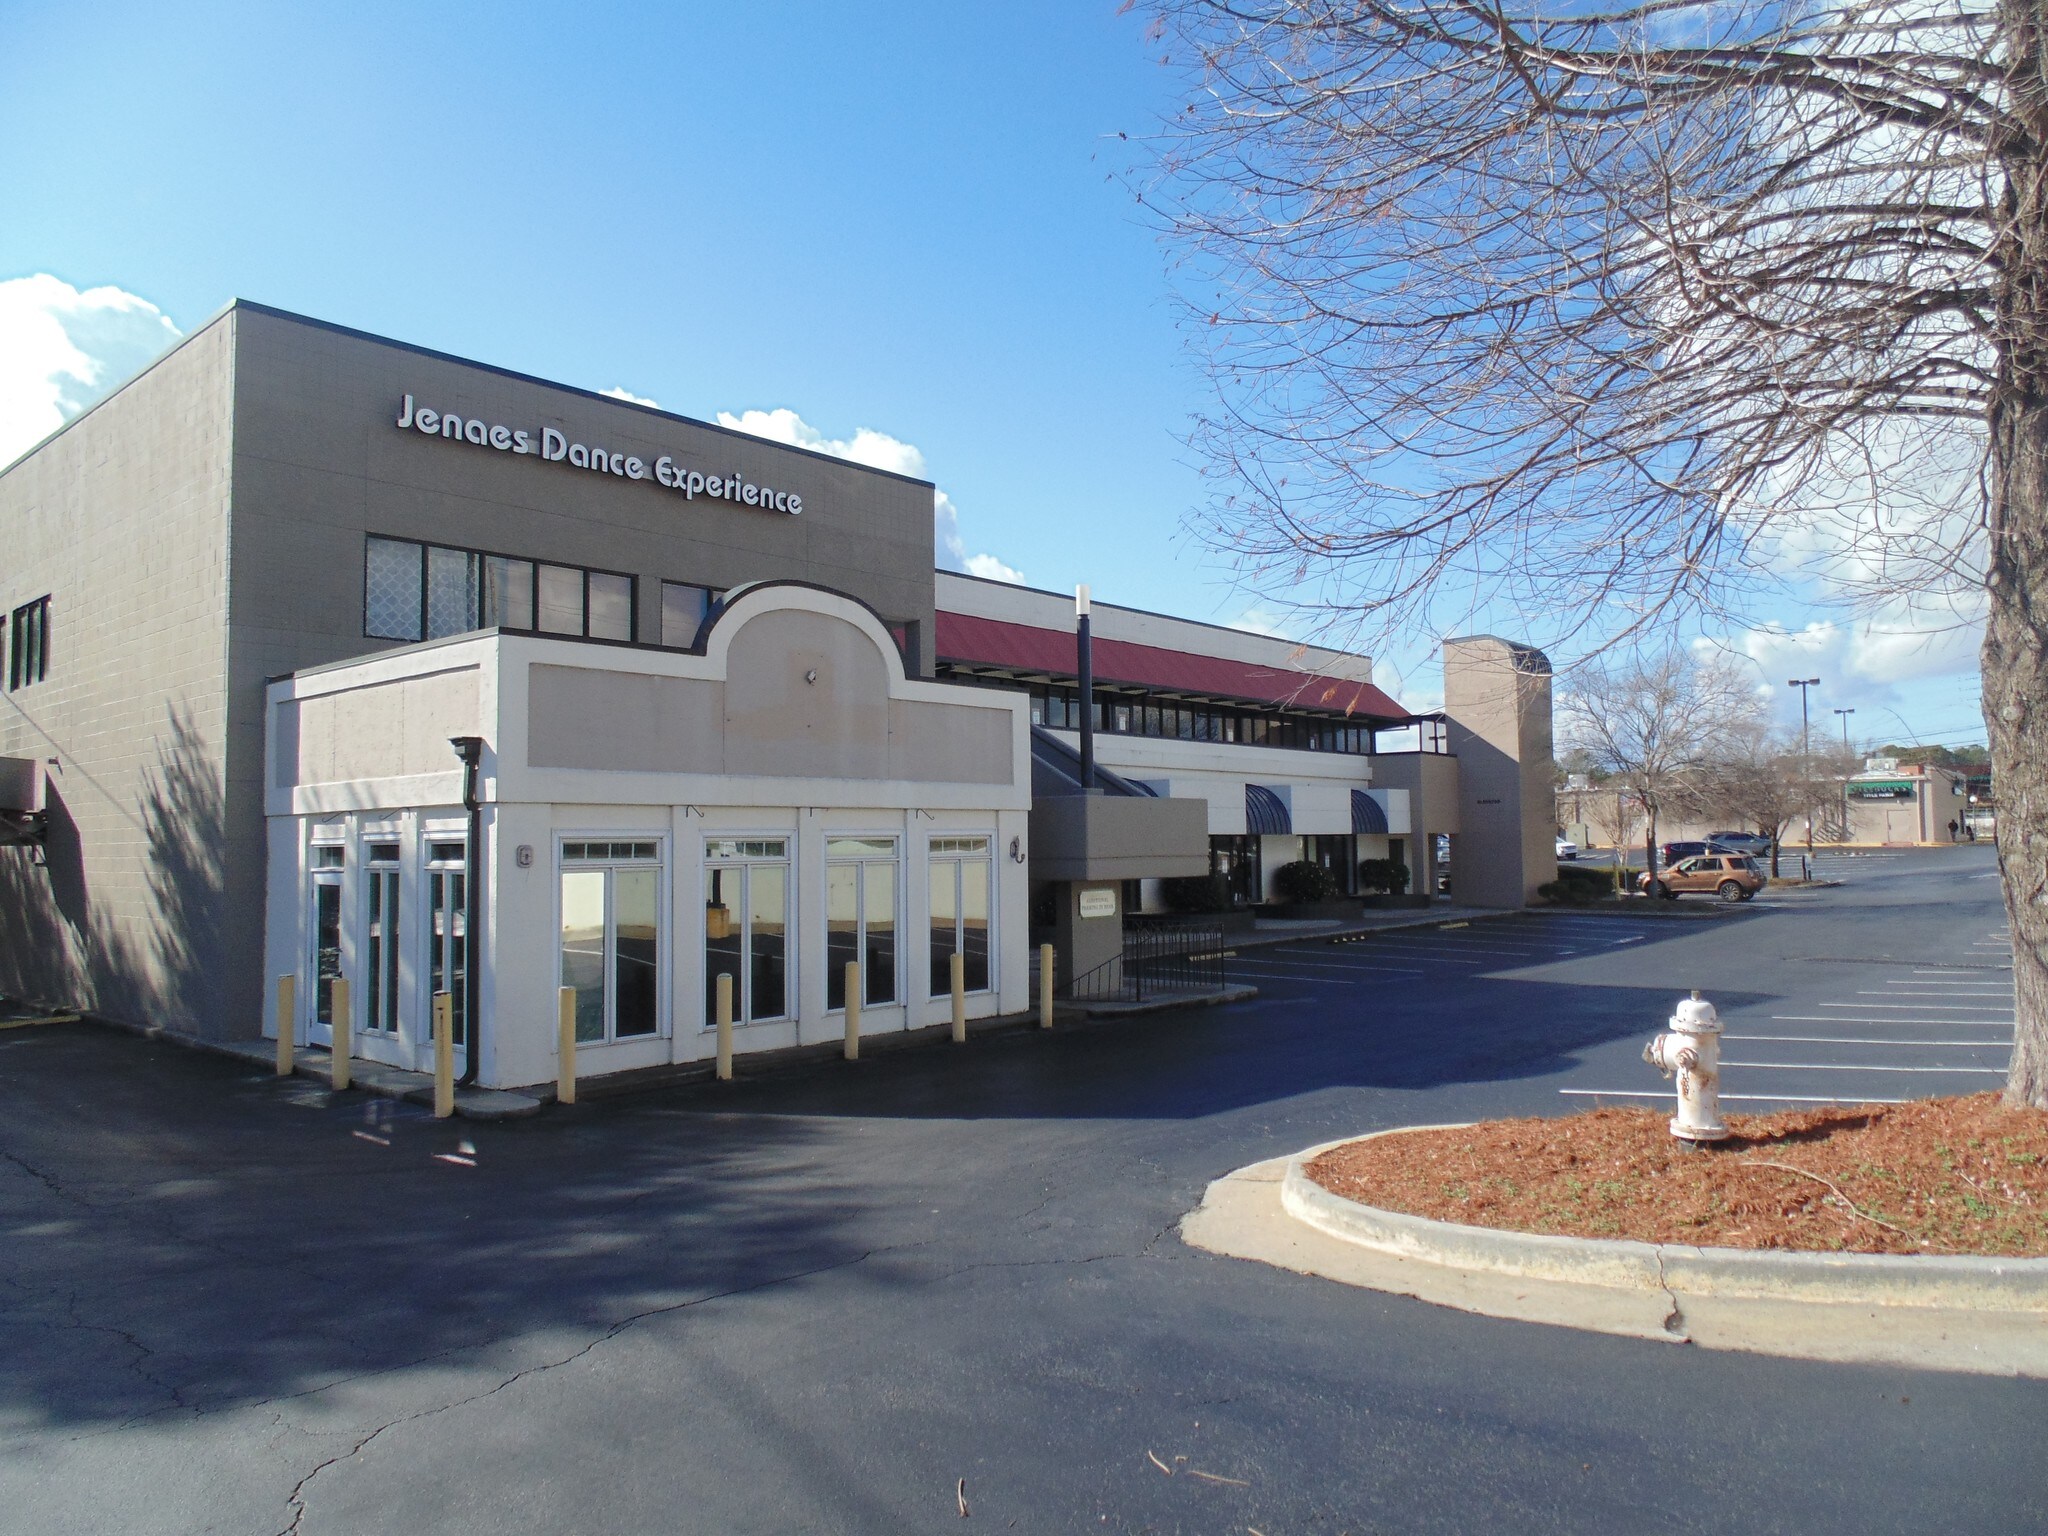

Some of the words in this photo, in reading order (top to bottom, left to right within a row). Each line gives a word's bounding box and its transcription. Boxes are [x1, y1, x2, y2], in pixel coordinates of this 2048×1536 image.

[397, 394, 530, 455] Jenaes
[540, 426, 646, 481] Dance
[654, 456, 803, 516] Experience
